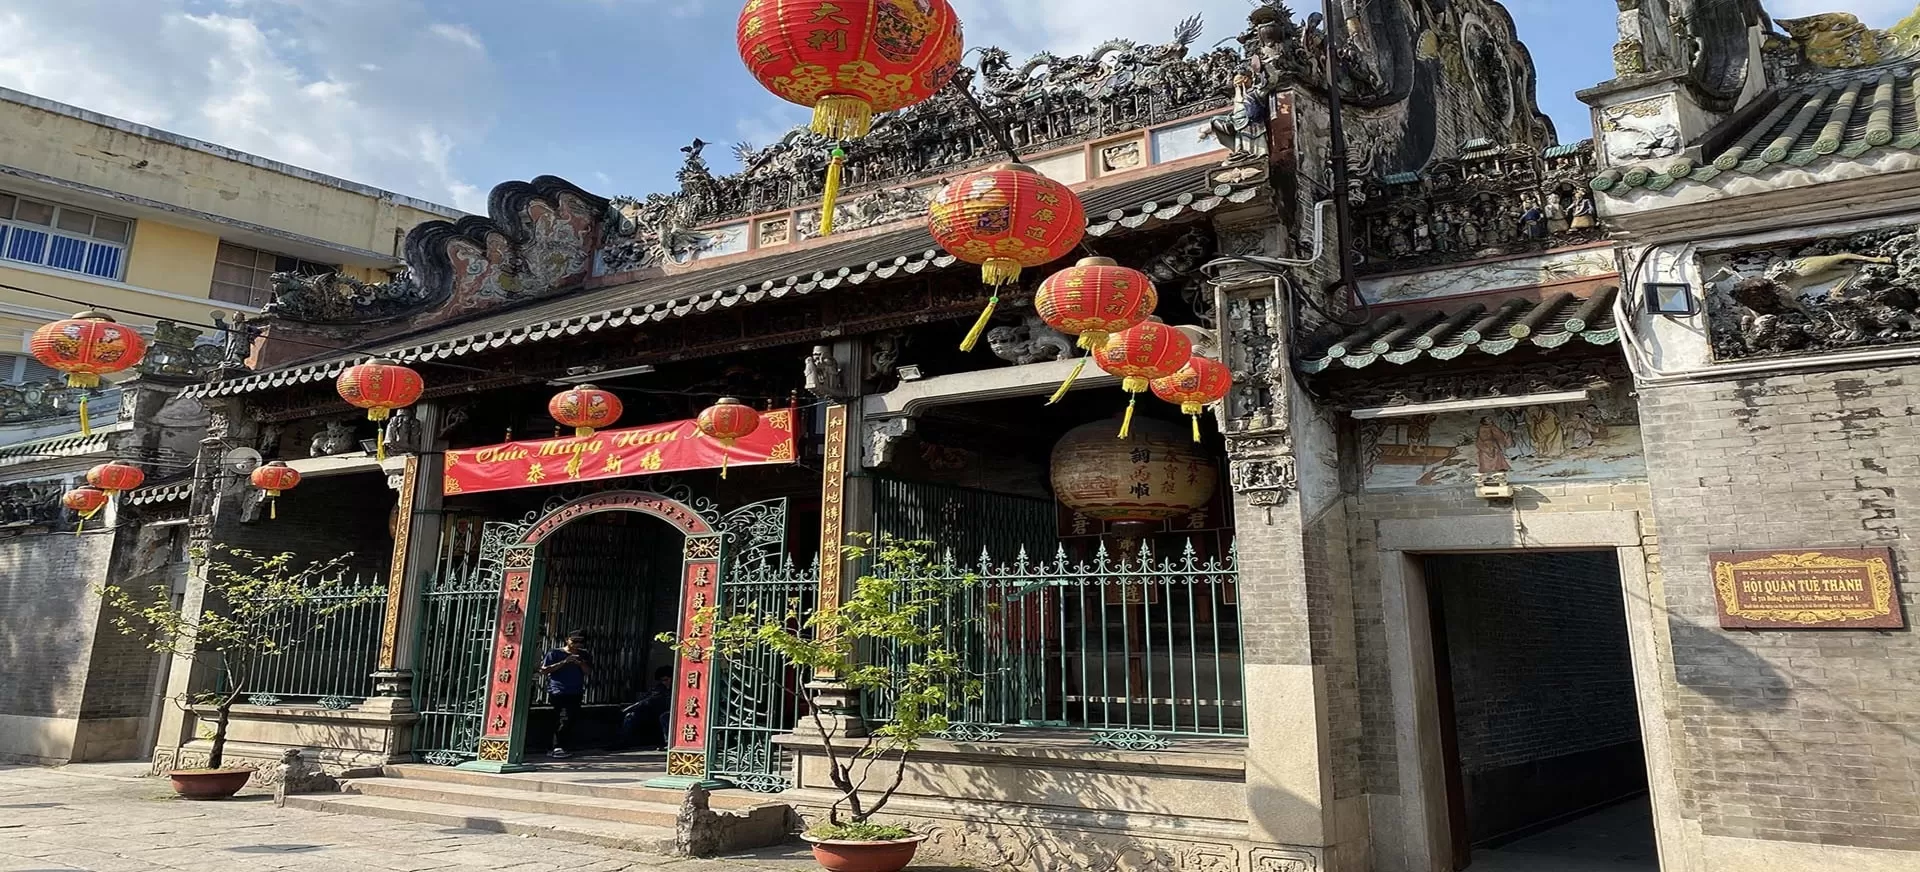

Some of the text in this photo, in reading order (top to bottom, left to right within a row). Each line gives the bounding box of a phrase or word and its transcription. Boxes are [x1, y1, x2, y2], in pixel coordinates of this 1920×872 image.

[476, 446, 529, 464] Chúc
[532, 438, 605, 458] Mừng
[612, 429, 679, 448] Năm
[527, 453, 662, 483] 恭賀新禧
[1743, 575, 1863, 595] HỘI QUÁN TUỆ THÀNH
